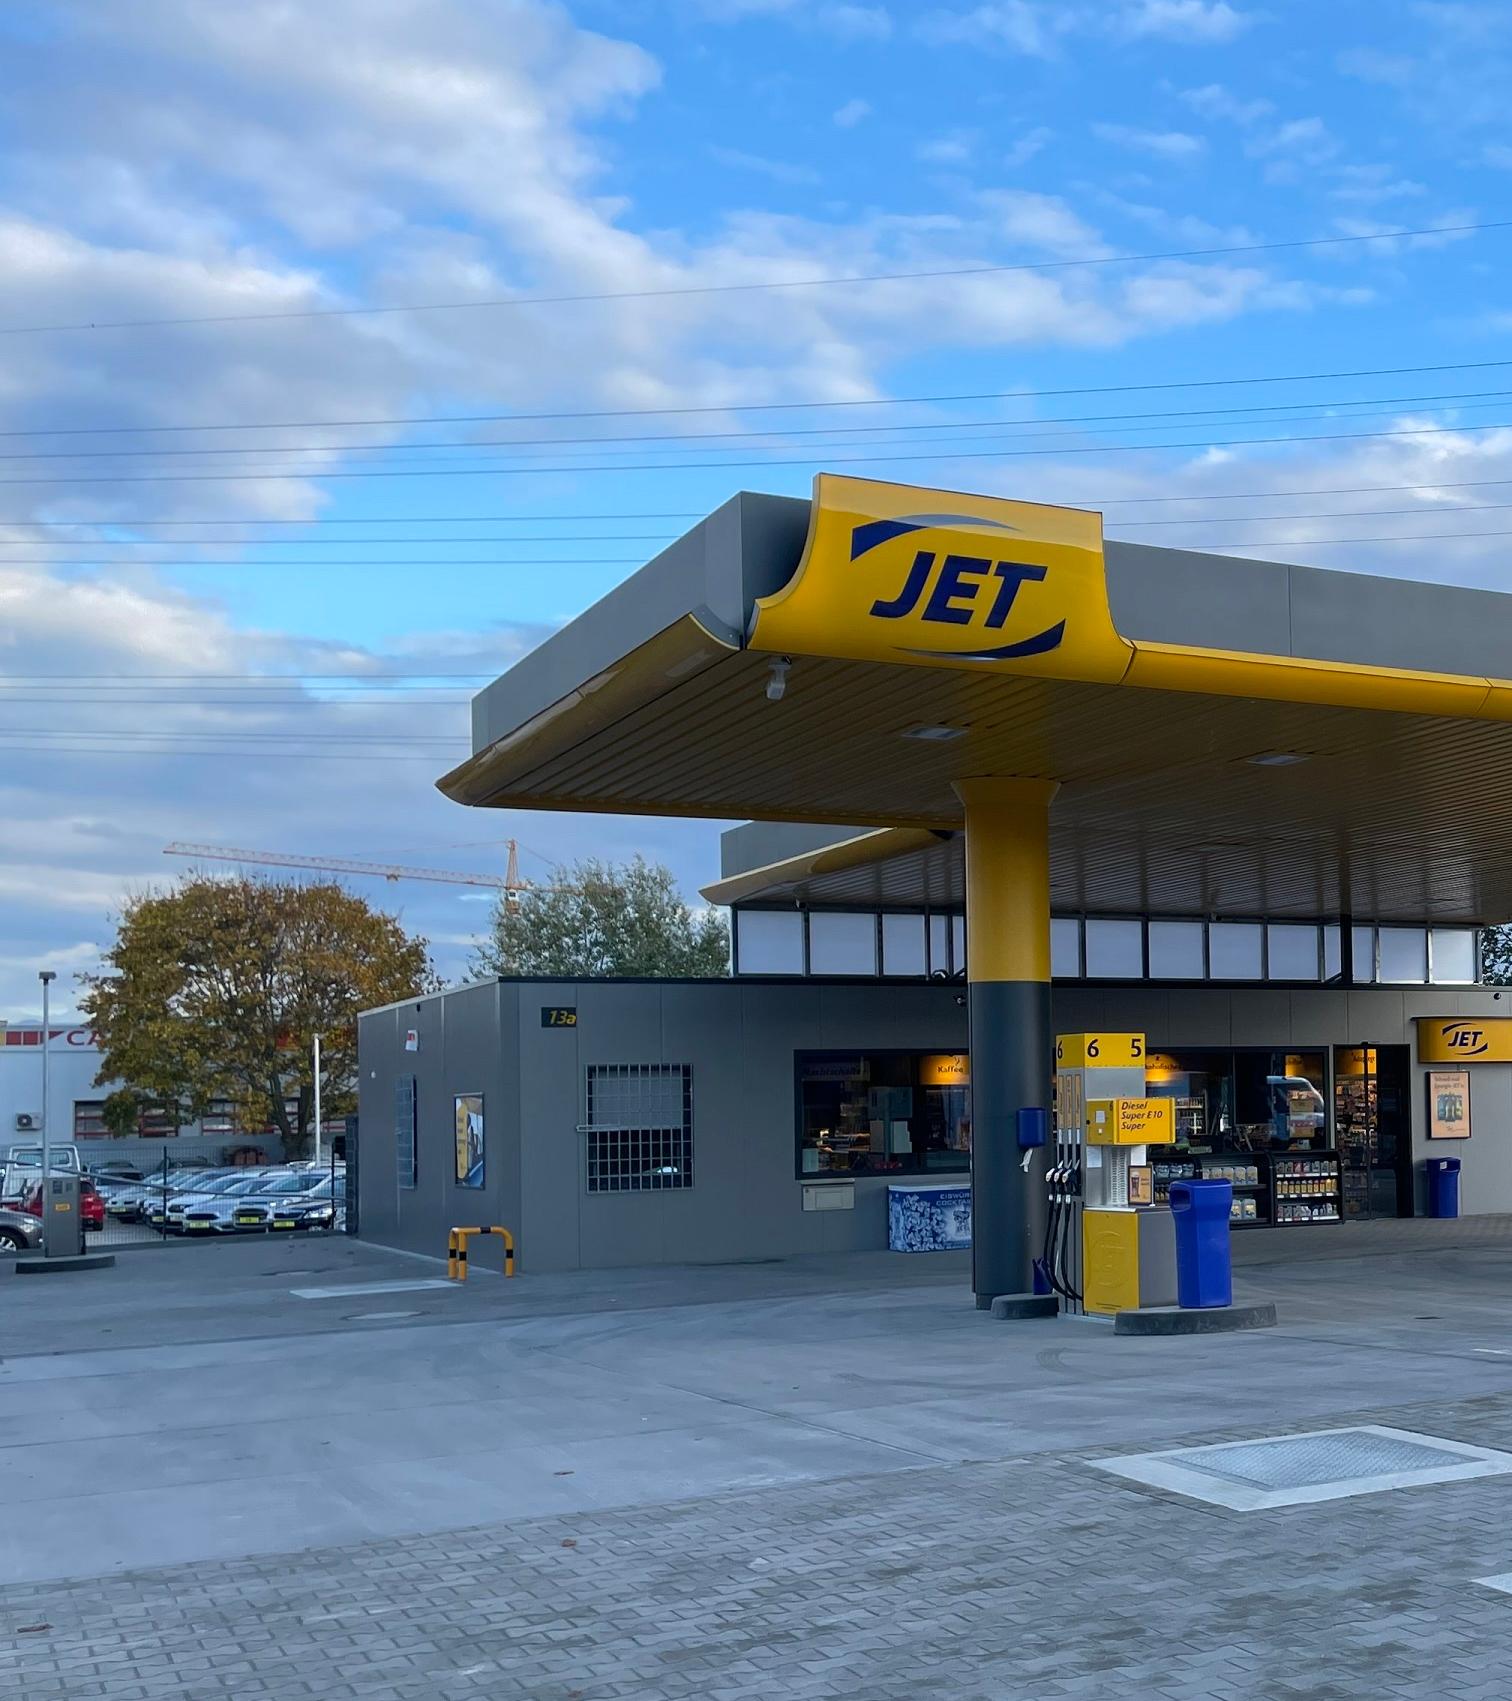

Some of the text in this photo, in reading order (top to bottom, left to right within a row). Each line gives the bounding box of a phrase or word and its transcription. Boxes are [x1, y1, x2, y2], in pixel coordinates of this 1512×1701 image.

[869, 551, 1048, 629] JET
[550, 1010, 576, 1025] 13a
[1447, 1031, 1483, 1047] JET
[1057, 1040, 1063, 1059] 6
[1087, 1038, 1100, 1058] 6
[1131, 1038, 1142, 1058] 5
[937, 1065, 964, 1073] Kaffee
[1121, 1101, 1148, 1110] Diesel
[1121, 1110, 1163, 1121] Super E10
[1121, 1122, 1146, 1130] Super
